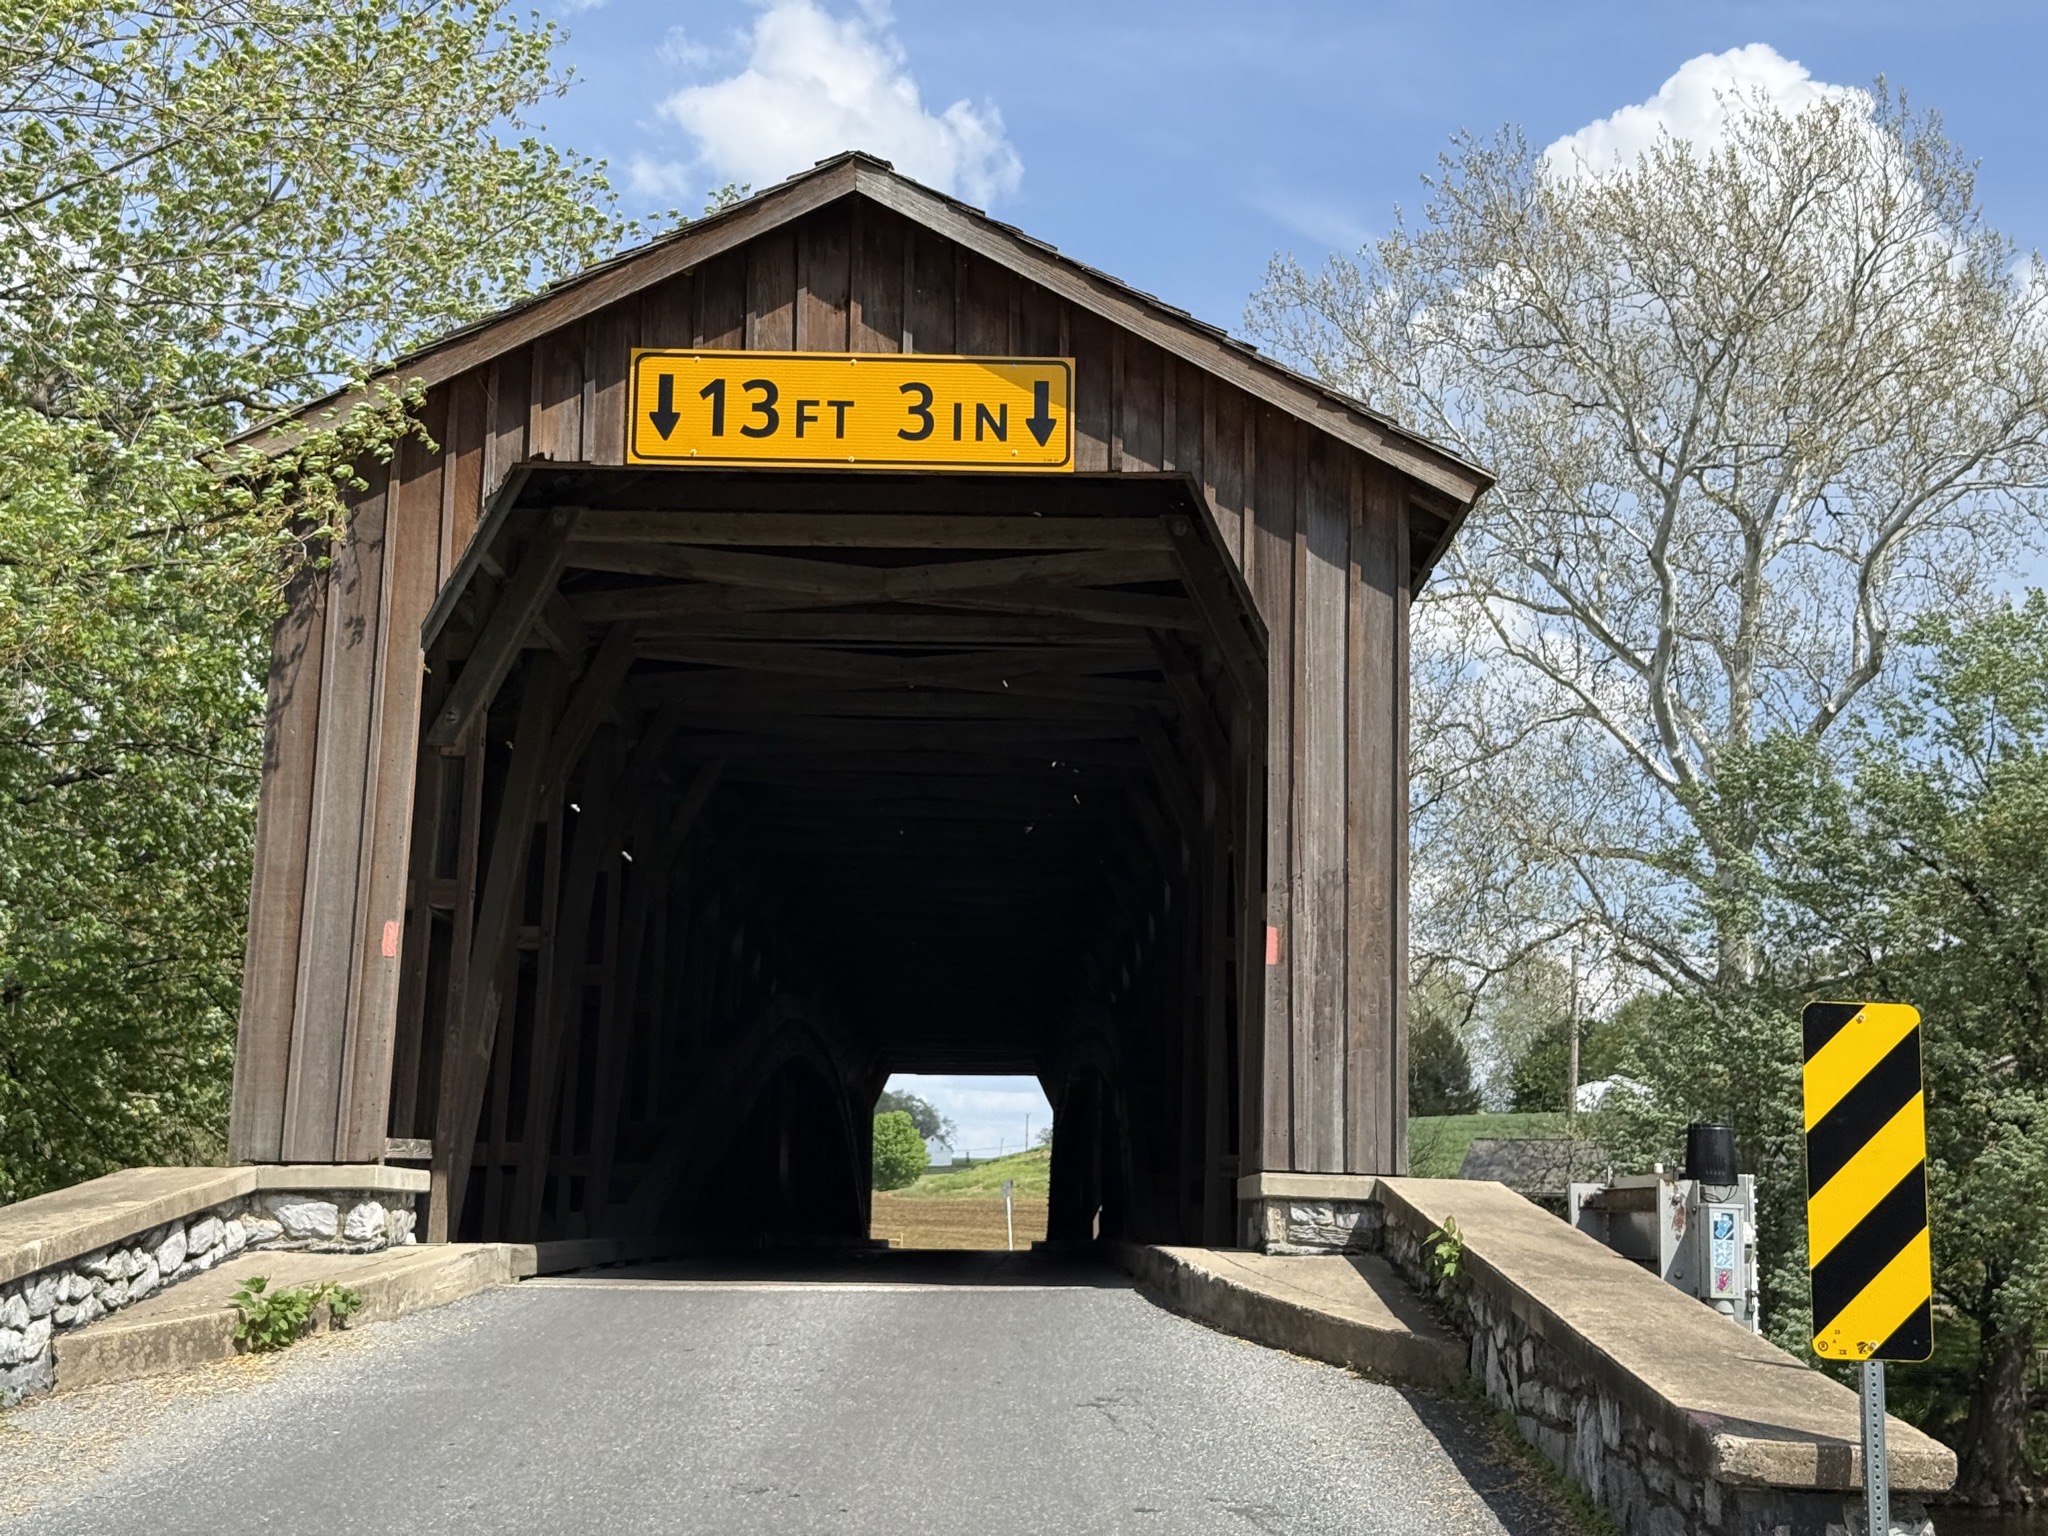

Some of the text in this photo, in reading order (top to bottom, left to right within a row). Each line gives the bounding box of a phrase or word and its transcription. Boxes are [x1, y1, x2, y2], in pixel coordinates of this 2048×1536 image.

[699, 378, 1008, 442] 13 FT 3 IN
